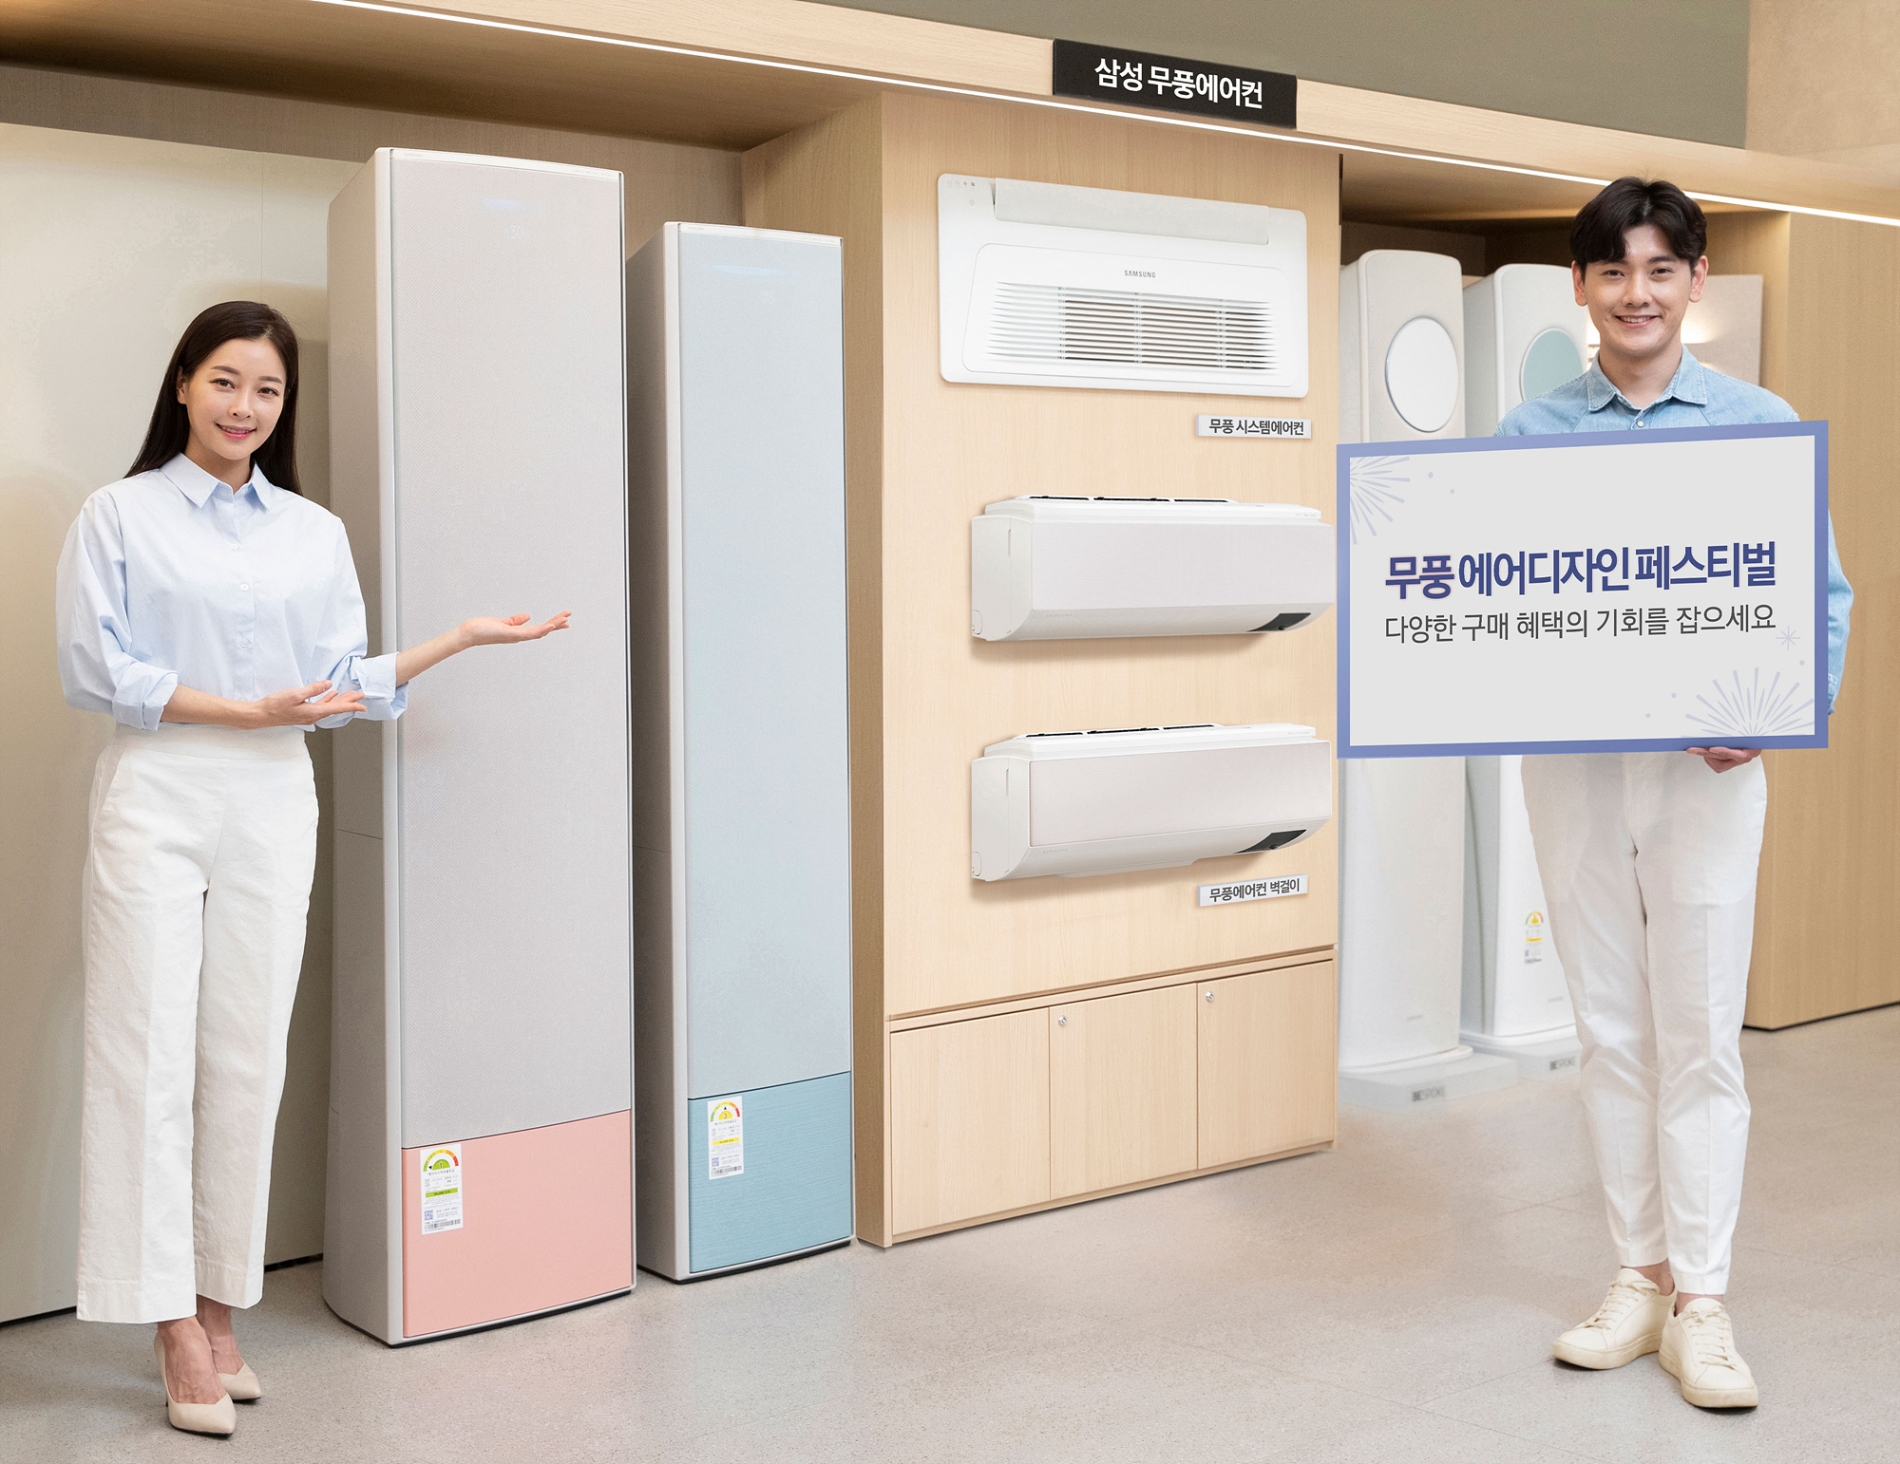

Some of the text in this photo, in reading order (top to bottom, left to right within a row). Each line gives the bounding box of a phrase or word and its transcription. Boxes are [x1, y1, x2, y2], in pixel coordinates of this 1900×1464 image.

[1095, 58, 1263, 109] 삼성 무풍에어컨
[1124, 269, 1156, 279] SAMSUNG
[1208, 418, 1304, 436] 무풍 시스템에어컨
[1385, 541, 1777, 600] 무풍 에어디자인 페스티벌
[1385, 603, 1777, 644] 다양한 구매 혜택의 기회를 잡으세요
[1209, 878, 1300, 903] 무풍에어컨 벽걸이
